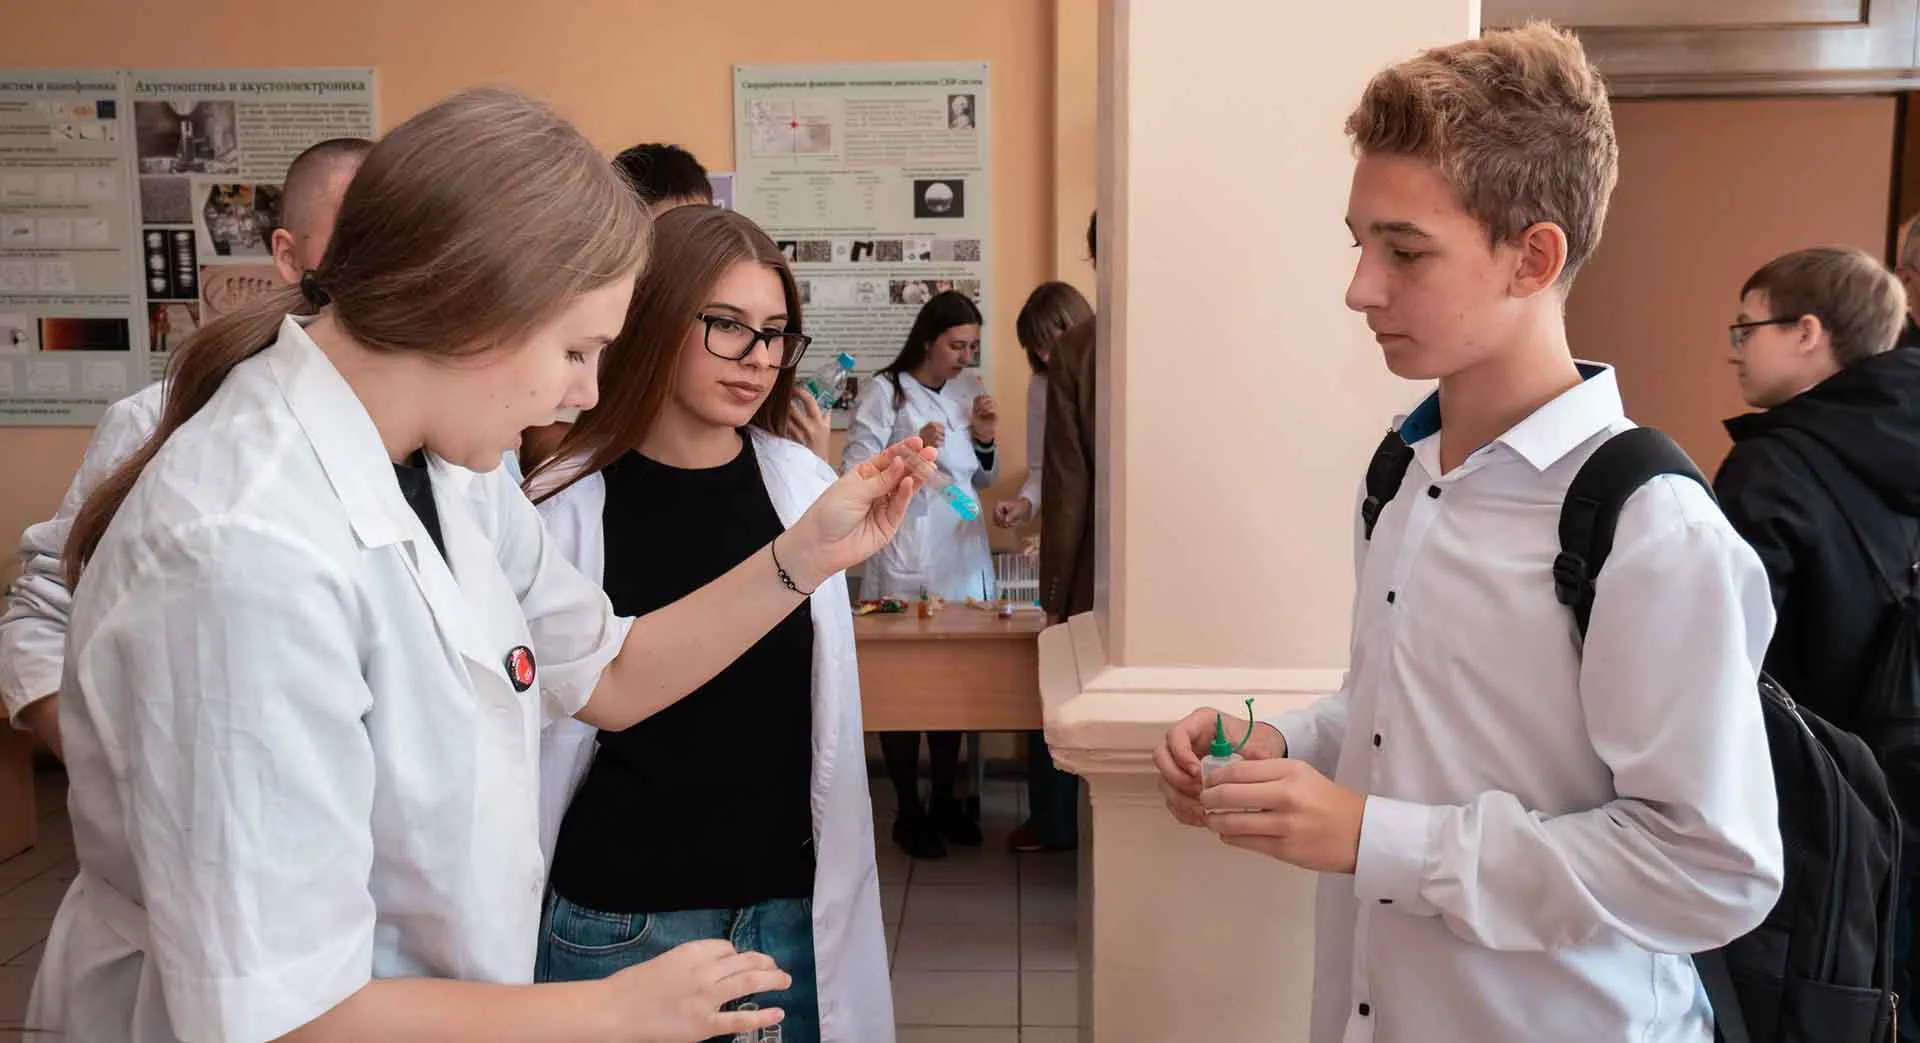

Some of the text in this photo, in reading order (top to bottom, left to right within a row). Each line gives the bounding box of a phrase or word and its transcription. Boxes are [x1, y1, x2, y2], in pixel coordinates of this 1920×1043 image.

[135, 79, 366, 96] Акустооптика и акустоэлектроника
